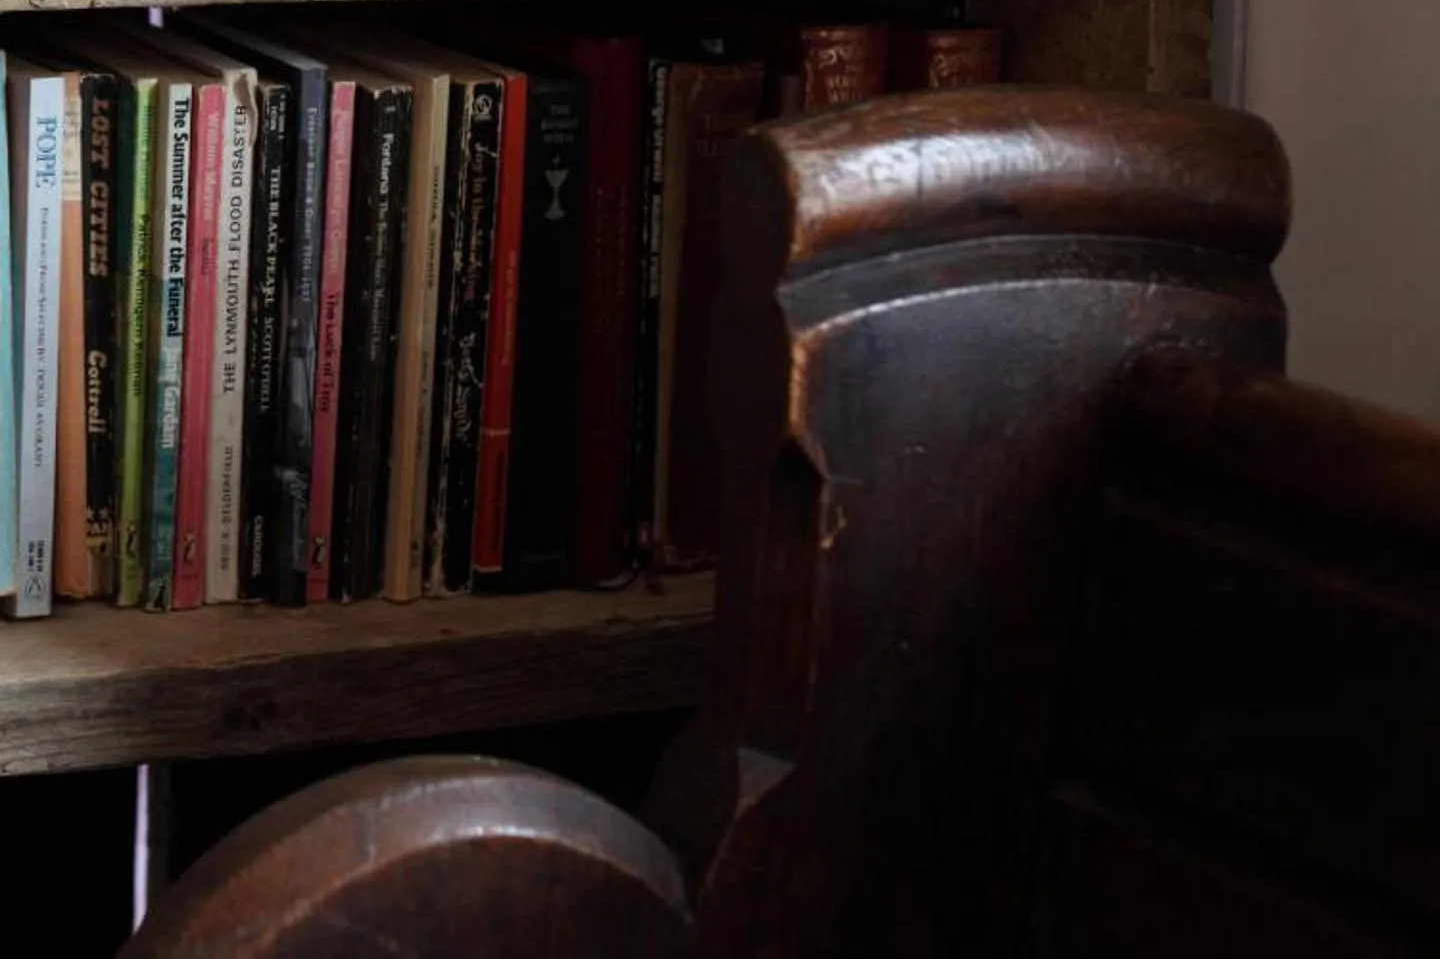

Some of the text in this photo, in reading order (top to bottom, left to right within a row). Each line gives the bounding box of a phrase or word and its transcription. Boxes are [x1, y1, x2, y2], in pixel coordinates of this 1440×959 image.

[36, 116, 57, 188] POPE
[205, 112, 220, 169] William
[379, 133, 395, 195] Fontana
[89, 95, 110, 278] LOST CITIES
[167, 98, 189, 337] The Summer after the Funeral
[136, 213, 151, 263] Patrick
[222, 105, 248, 393] THE LYNMOUTH FLOOD DISASTER
[262, 166, 281, 305] THE BLACK PEARL
[131, 341, 144, 397] Keenan
[261, 316, 275, 360] SCOTT
[320, 292, 340, 413] The Luck of Troy
[87, 349, 108, 433] Cottrell
[160, 347, 179, 449] Jane Gardam
[220, 445, 234, 525] DELDERFIELD
